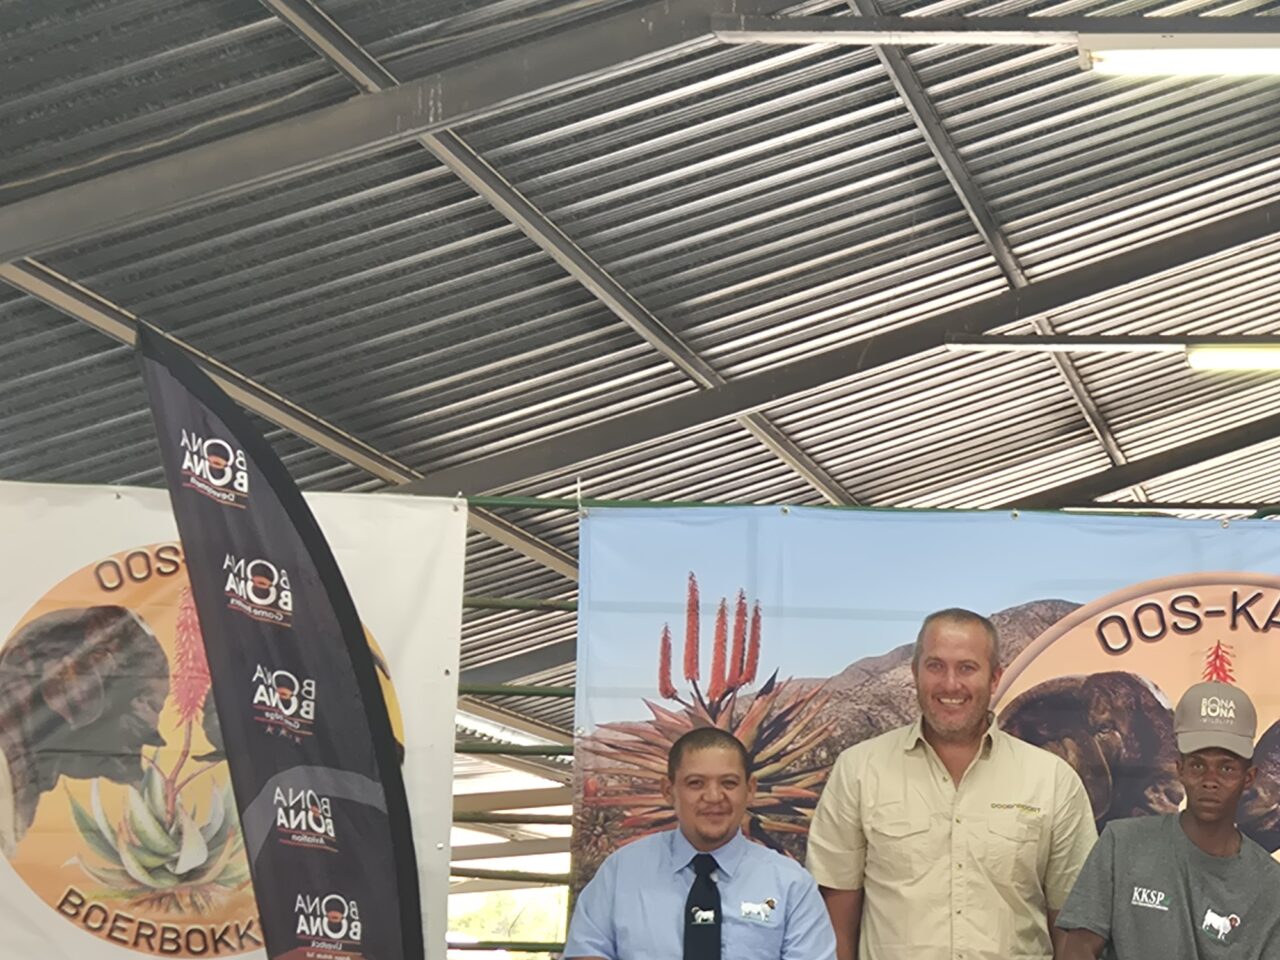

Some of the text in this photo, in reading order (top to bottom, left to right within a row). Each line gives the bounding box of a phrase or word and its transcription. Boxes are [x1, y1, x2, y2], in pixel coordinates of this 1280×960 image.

[95, 545, 182, 591] OOS
[1132, 886, 1165, 905] KKSP
[57, 887, 264, 956] BOERBOKK
